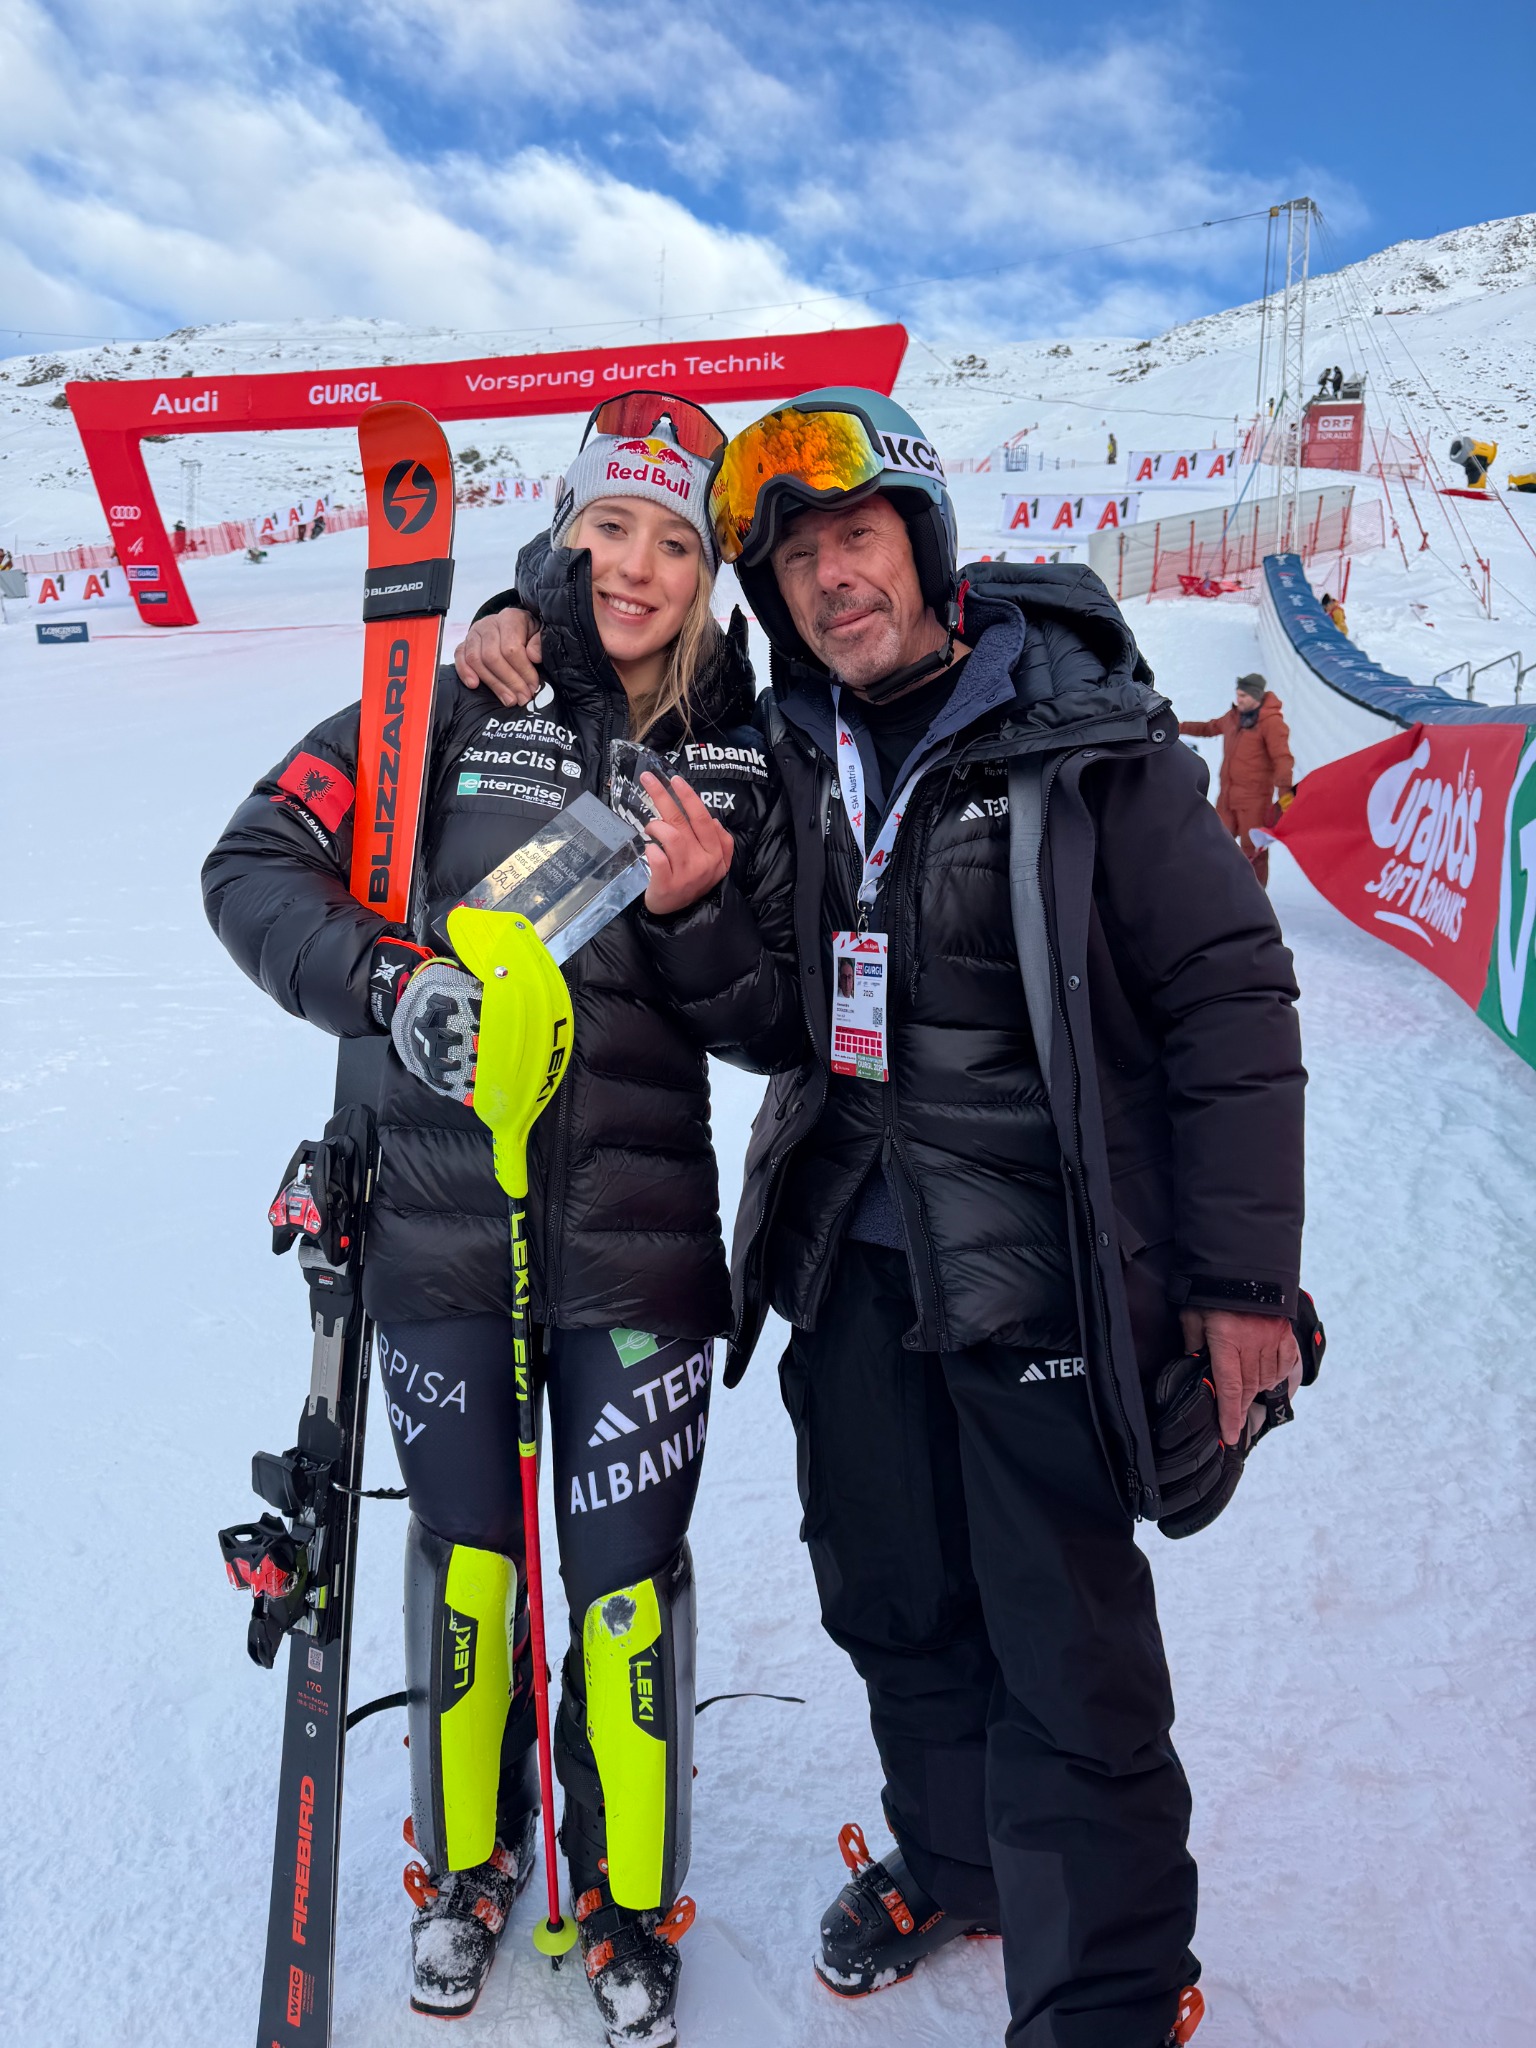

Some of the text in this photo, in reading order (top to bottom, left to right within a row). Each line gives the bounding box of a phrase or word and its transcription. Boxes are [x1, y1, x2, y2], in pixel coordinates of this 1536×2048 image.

[465, 351, 785, 392] Vorsprung durch Technik
[151, 391, 219, 415] Audi
[308, 382, 383, 405] GURGL
[1321, 418, 1352, 428] ORF
[606, 462, 690, 500] Red Bull
[1136, 450, 1236, 482] A1 A1 A1
[261, 494, 329, 534] A1 A1 A1
[1009, 497, 1130, 530] A1 A1 A1
[38, 570, 110, 604] A1 A1
[370, 581, 424, 597] BLIZZARD
[368, 638, 410, 903] BLIZZARD
[459, 746, 556, 771] SanaClis
[685, 743, 767, 768] Fibank
[689, 762, 768, 778] First Investment Bank
[463, 778, 562, 802] enterprise
[521, 794, 560, 806] rent-a-car
[848, 765, 860, 810] Ski Austria
[298, 810, 330, 848] ALBANIA
[870, 849, 891, 867] A1
[1364, 858, 1466, 942] SOFT DRINKS
[864, 965, 883, 976] GURGL
[536, 1017, 567, 1102] LEKI
[511, 1211, 530, 1305] LEKI
[380, 1332, 465, 1413] RPISA
[571, 1412, 707, 1514] ALBANIA
[454, 1625, 471, 1689] LEKI
[306, 1680, 322, 1694] 170
[636, 1661, 654, 1721] LEKI
[292, 1775, 315, 1946] FIREBIRD
[838, 1900, 862, 1926] TECNICA
[290, 1970, 300, 2017] WRC
